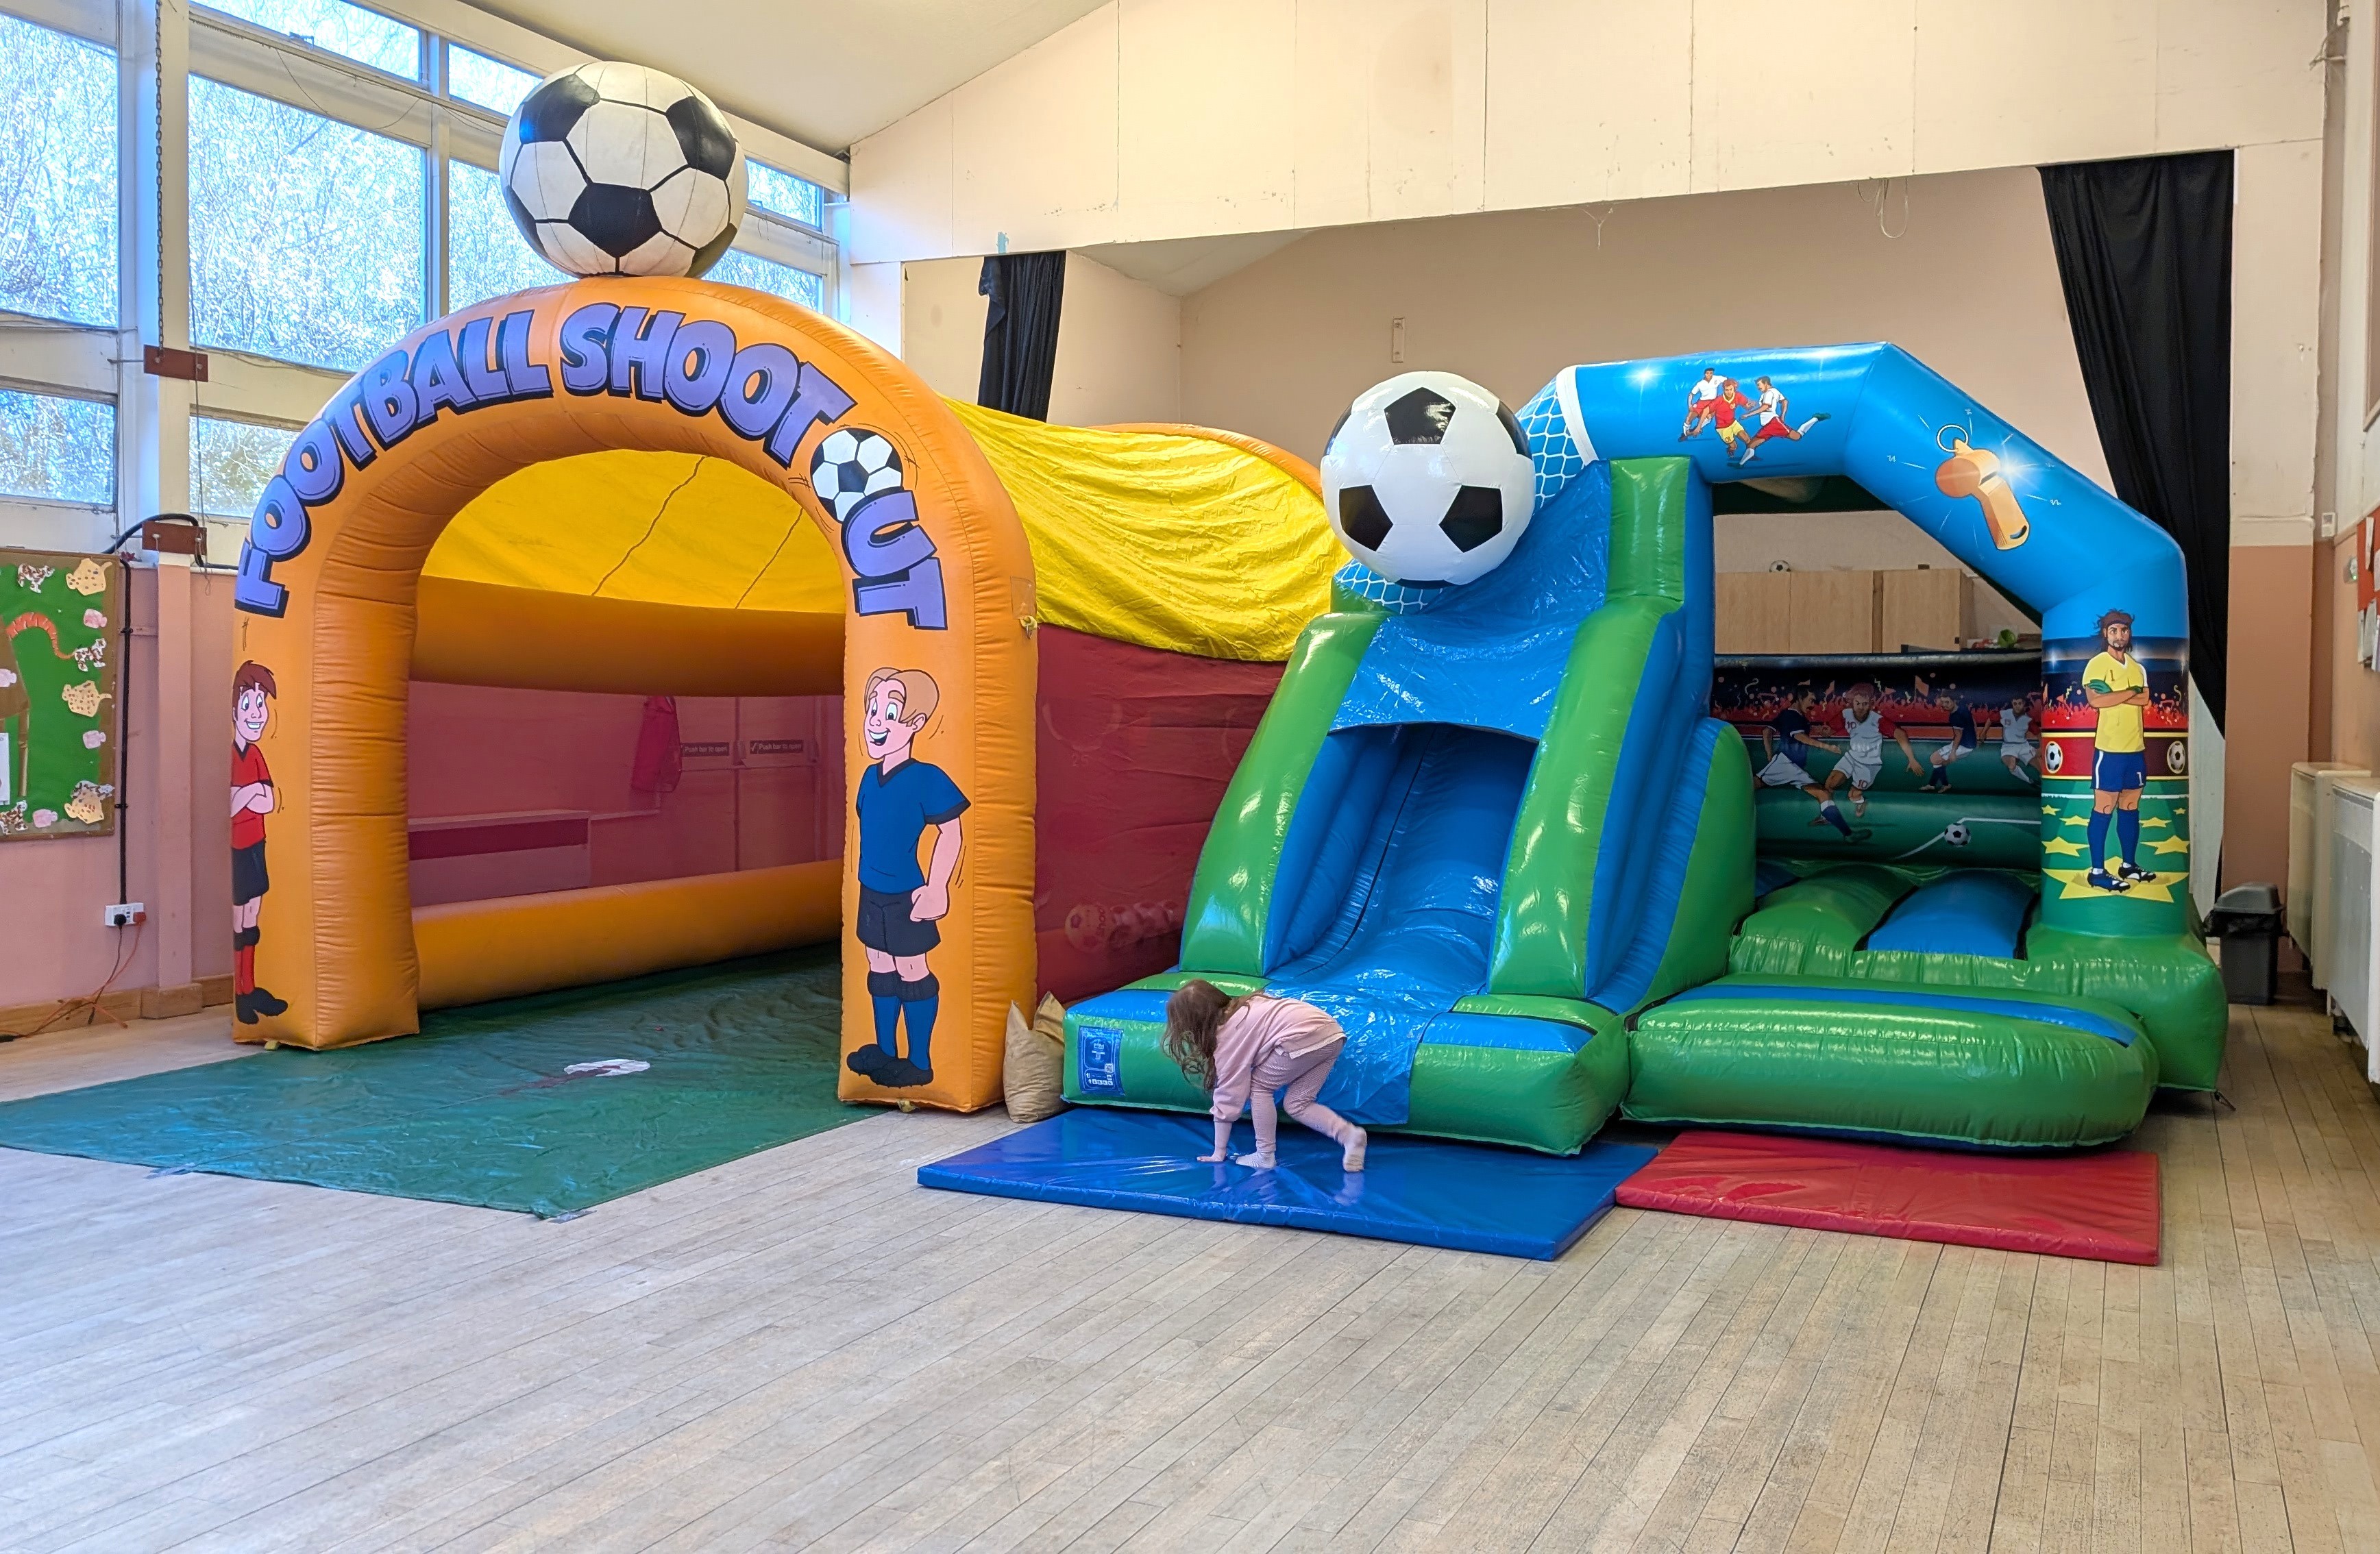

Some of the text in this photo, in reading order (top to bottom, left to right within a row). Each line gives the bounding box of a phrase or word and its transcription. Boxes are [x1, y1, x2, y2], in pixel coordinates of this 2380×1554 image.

[234, 308, 553, 617] FOOTBALL
[559, 302, 857, 469] SHOOT
[2109, 669, 2115, 682] 1
[2136, 772, 2144, 787] 1
